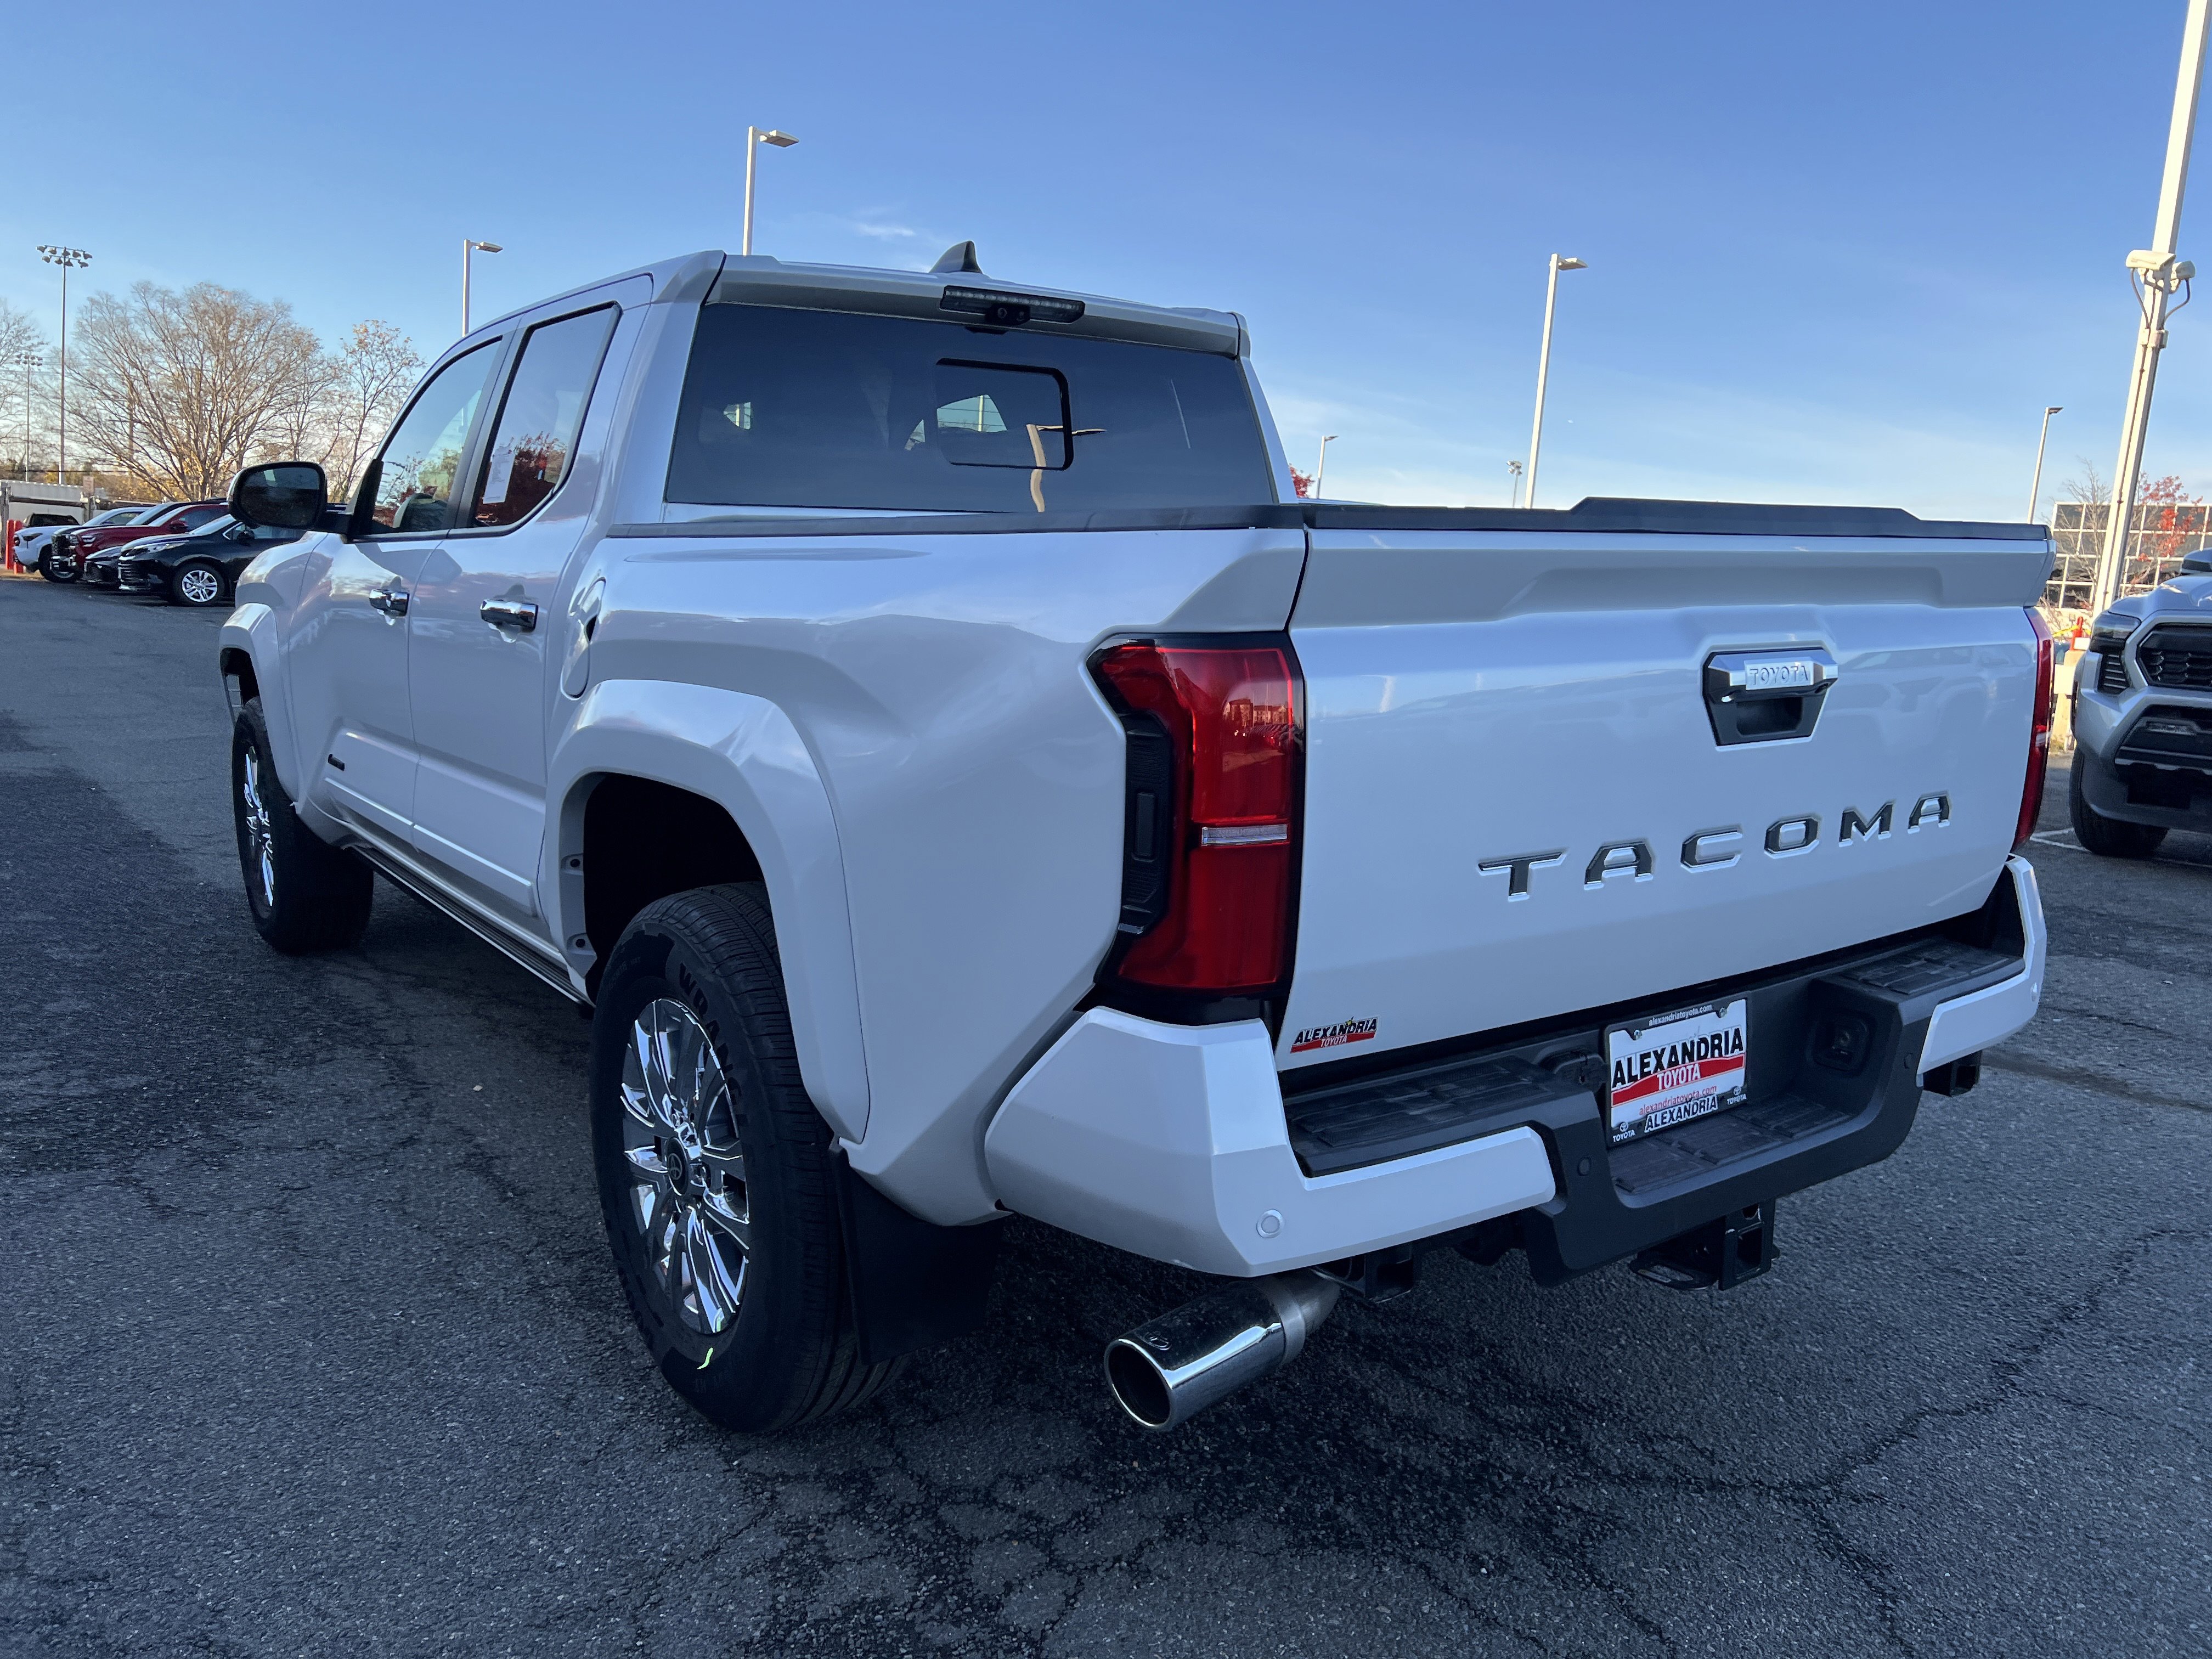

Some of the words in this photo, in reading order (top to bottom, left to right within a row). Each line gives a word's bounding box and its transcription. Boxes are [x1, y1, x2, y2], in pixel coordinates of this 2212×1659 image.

[1750, 665, 1808, 685] TOYOTA
[1477, 790, 1951, 902] TACOMA
[1649, 1004, 1712, 1026] alexandriatoyota.com
[1293, 1018, 1378, 1045] ALEXANDRIA
[1321, 1035, 1347, 1048] TOYOTA
[1611, 1027, 1743, 1089] ALEXANDRIA
[1656, 1063, 1701, 1091] TOYOTA
[1639, 1084, 1717, 1116] alexandriatoyota.com
[1726, 1093, 1747, 1105] TOYOTA
[1645, 1096, 1718, 1132] ALEXANDRIA
[1612, 1129, 1636, 1143] TOYOTA
